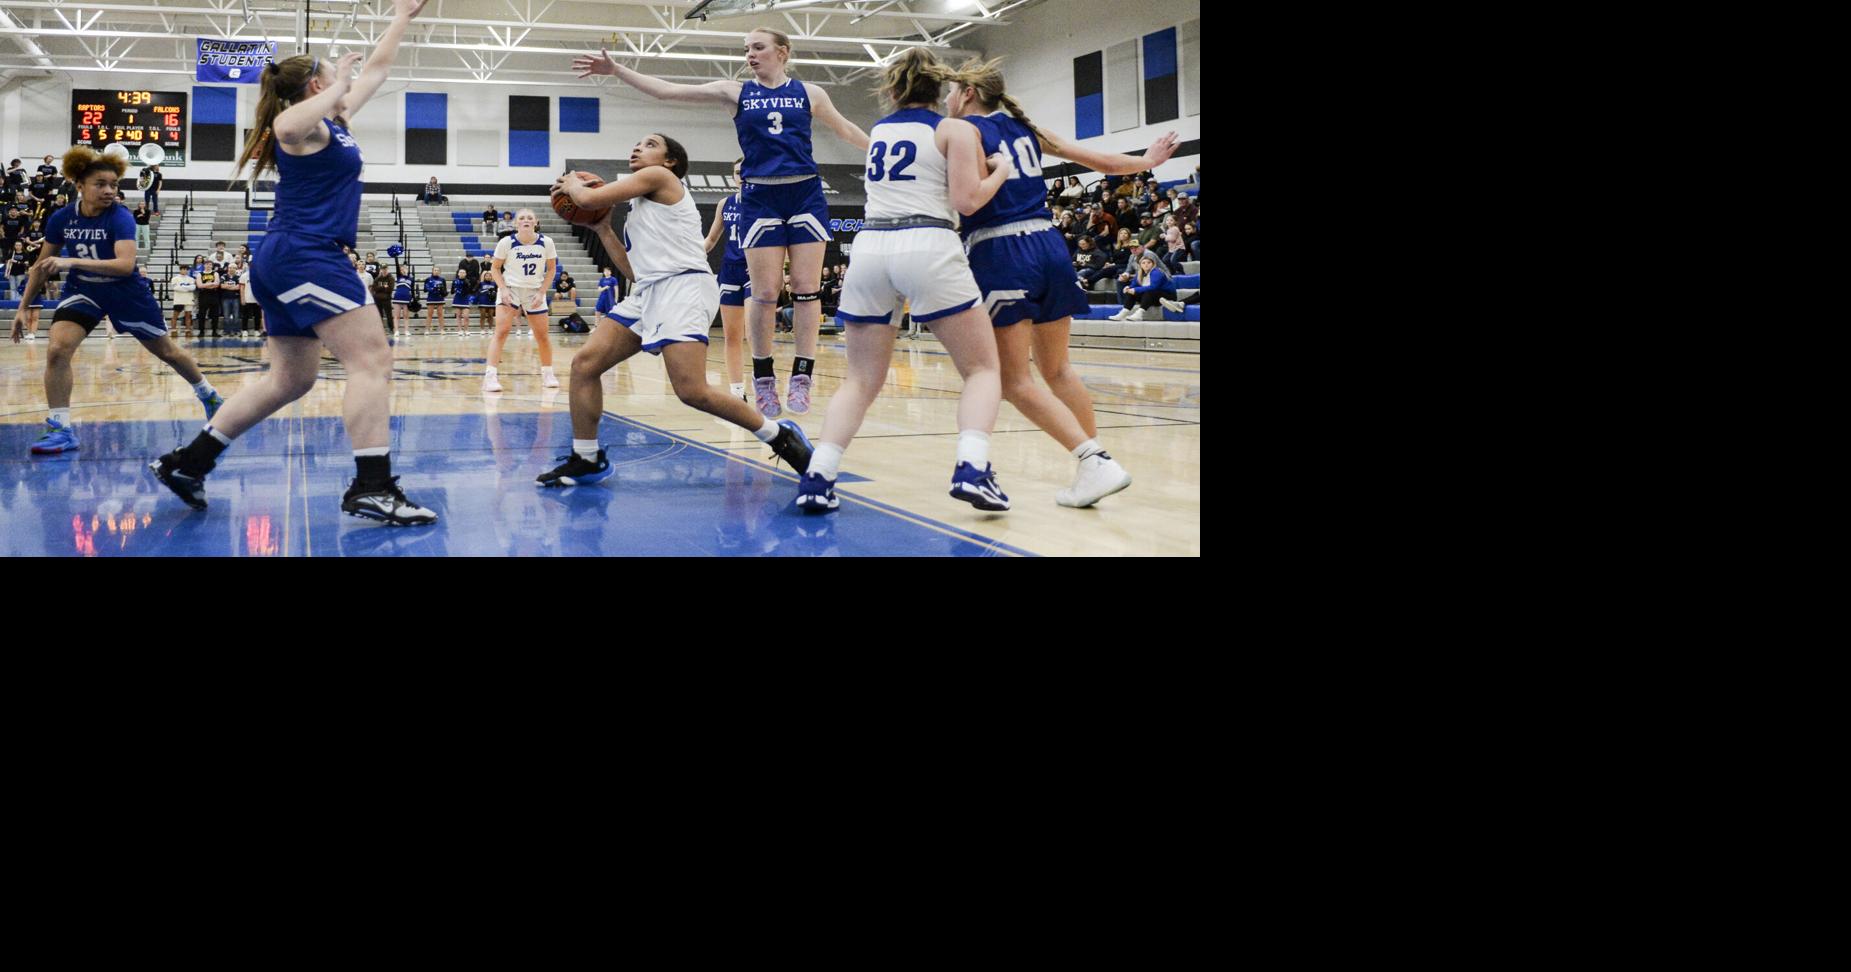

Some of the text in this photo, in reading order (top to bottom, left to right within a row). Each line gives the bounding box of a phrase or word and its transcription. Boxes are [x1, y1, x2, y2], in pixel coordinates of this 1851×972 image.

[200, 40, 275, 55] GALLATIN
[198, 53, 273, 67] STUDENTS
[118, 91, 151, 104] 4:39
[78, 104, 105, 112] RAPTORS
[153, 106, 180, 114] FALCONS
[743, 98, 804, 110] SKYVIEW
[82, 111, 103, 125] 22
[128, 114, 134, 124] 1
[163, 113, 179, 126] 16
[767, 111, 783, 134] 3
[82, 129, 91, 140] 5
[98, 129, 108, 140] 5
[114, 130, 143, 140] 2 40
[150, 131, 159, 141] 4
[169, 131, 179, 141] 4
[164, 151, 183, 161] ank
[867, 140, 917, 181] 32
[998, 136, 1043, 180] 10
[829, 218, 865, 232] ACH
[75, 242, 99, 260] 21
[516, 251, 542, 261] Raptors
[522, 263, 537, 276] 12
